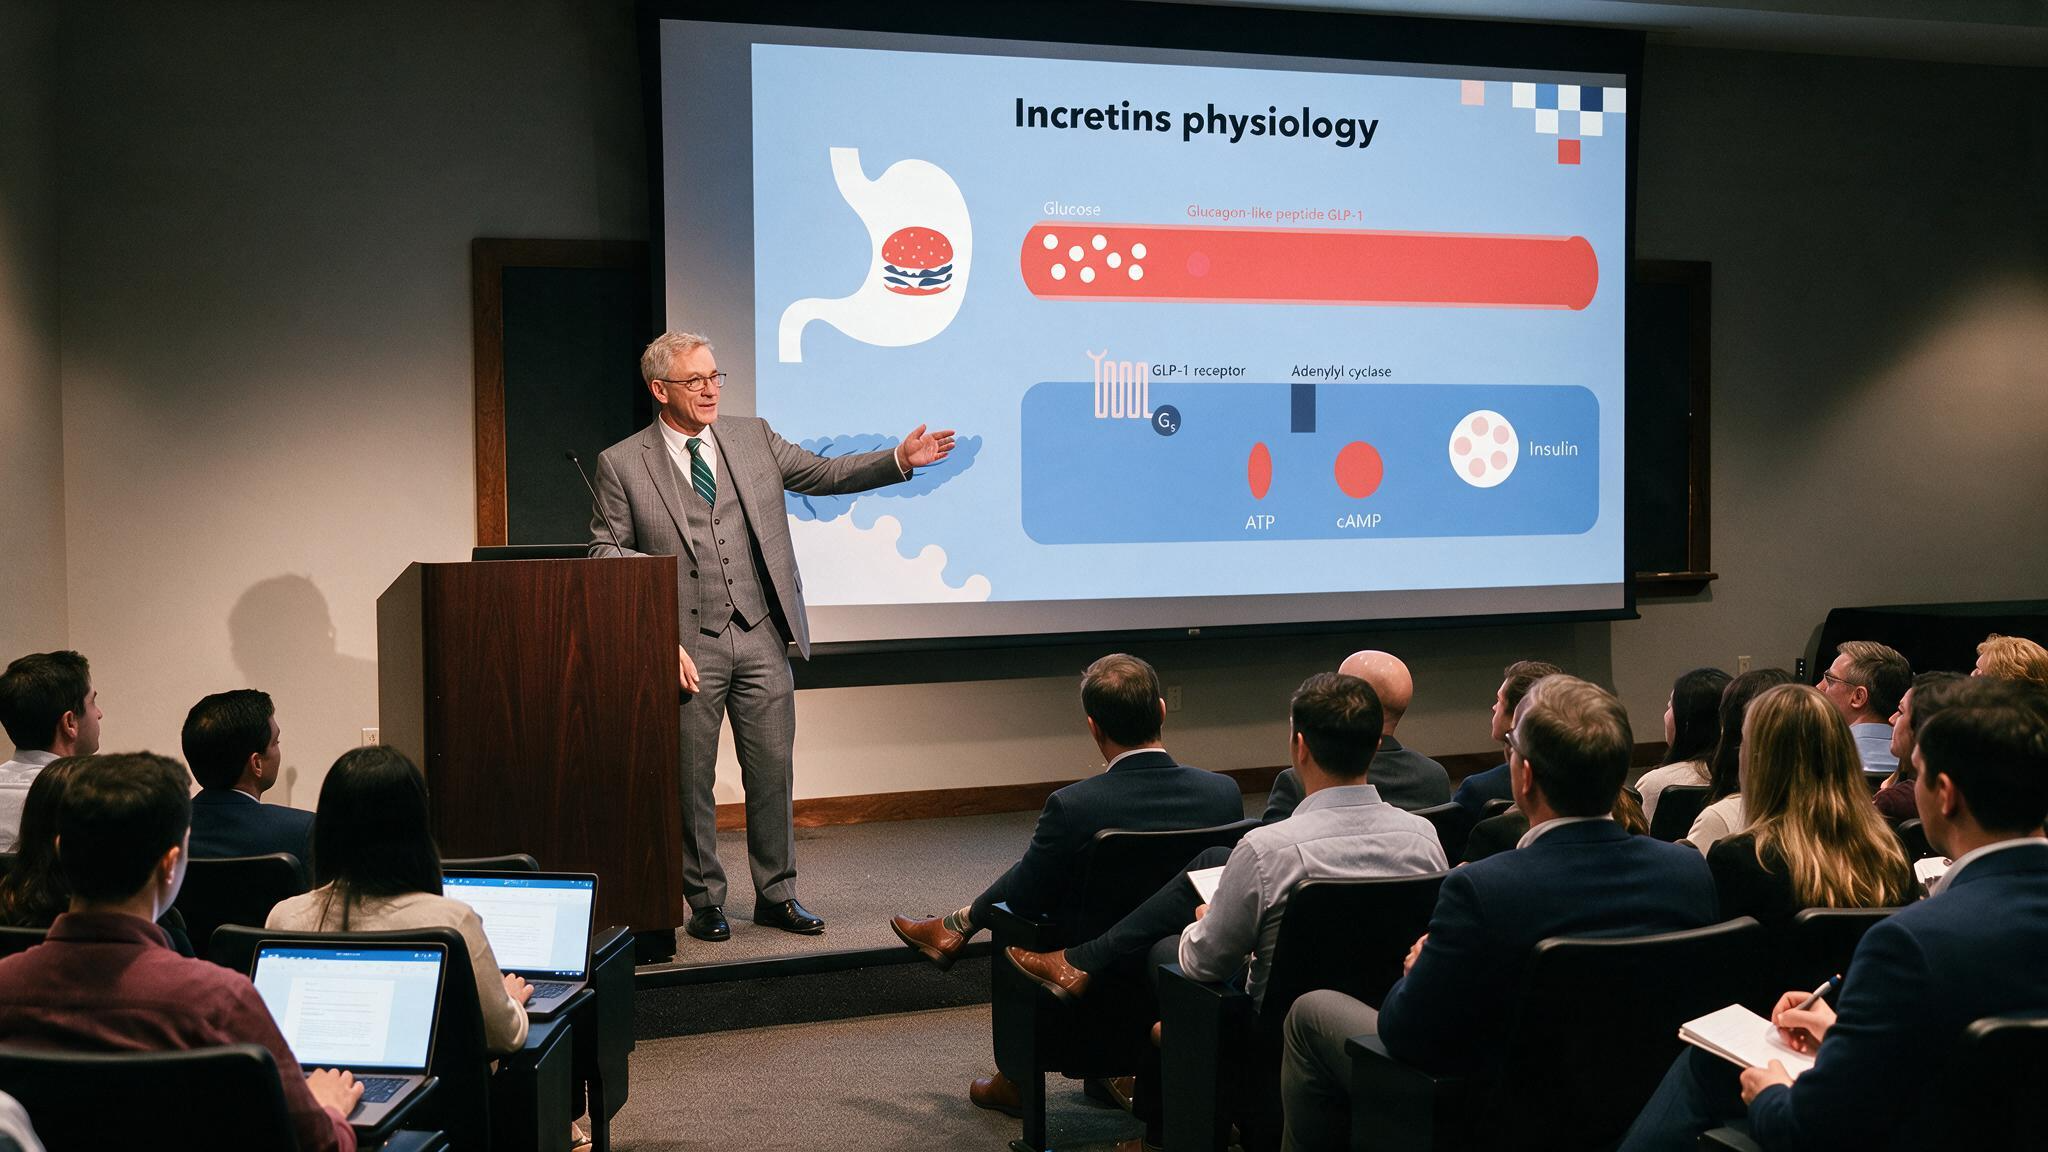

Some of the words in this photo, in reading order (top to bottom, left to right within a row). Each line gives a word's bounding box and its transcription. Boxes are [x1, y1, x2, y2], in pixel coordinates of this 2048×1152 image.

[1015, 97, 1171, 132] Incretins
[1183, 103, 1379, 148] physiology
[1043, 201, 1101, 217] Glucose
[1187, 204, 1273, 222] Glucagon-like
[1276, 207, 1325, 223] peptide
[1327, 208, 1364, 221] GLP-1
[1152, 364, 1189, 377] GLP-1
[1194, 365, 1246, 379] receptor
[1291, 364, 1345, 380] Adenylyl
[1348, 365, 1392, 380] cyclase
[1529, 441, 1579, 456] Insulin
[1245, 515, 1276, 530] ATP
[1336, 513, 1382, 530] cAMP
